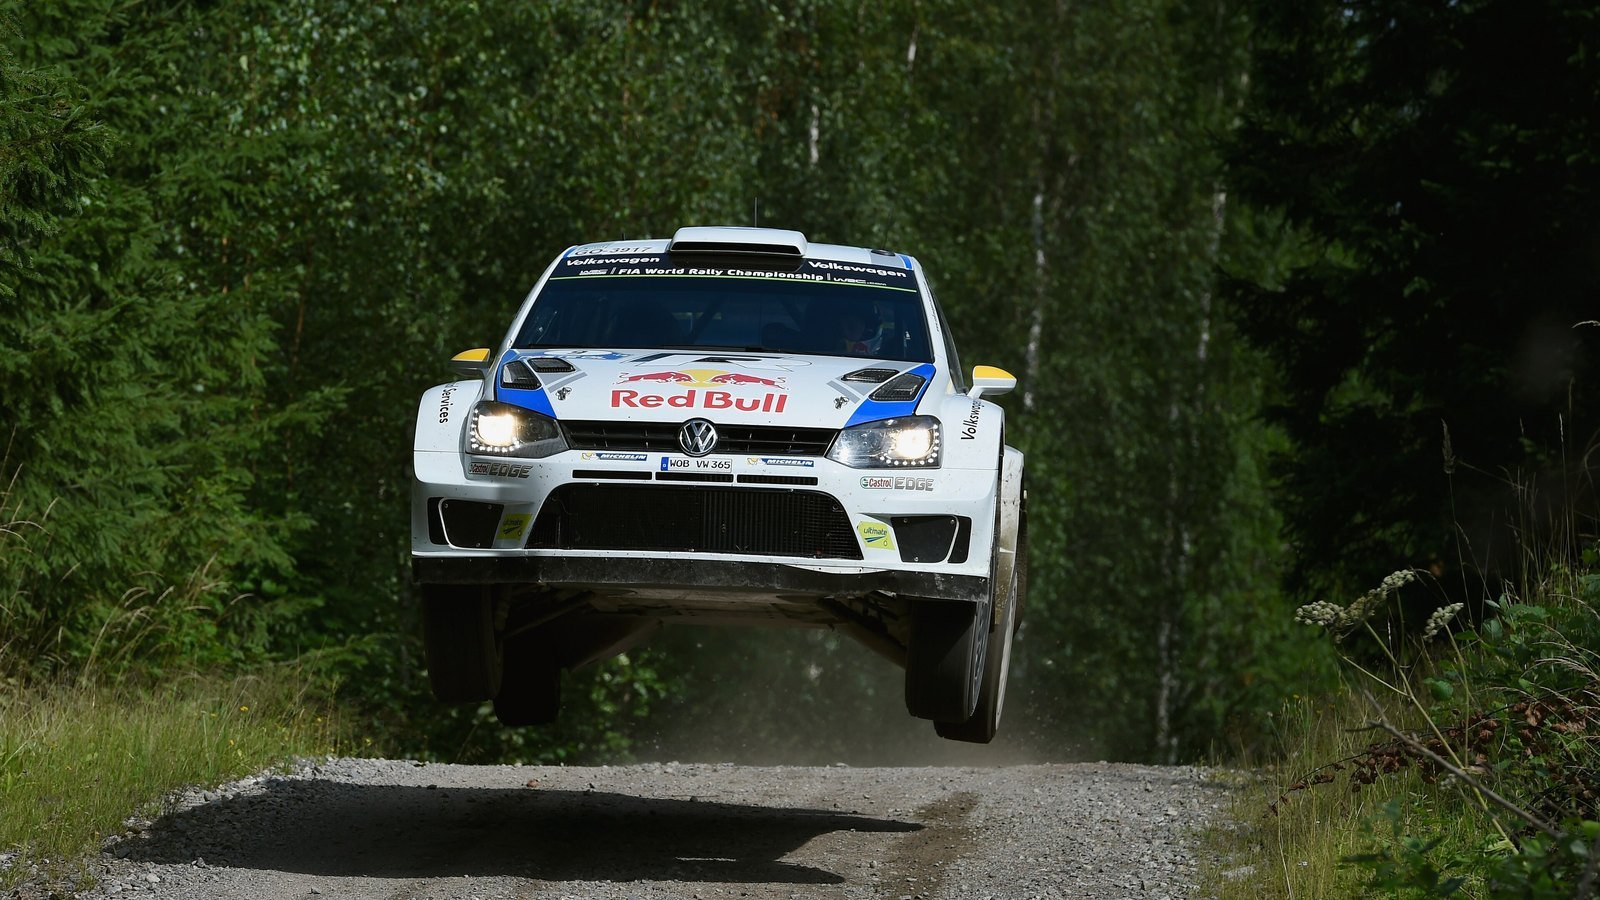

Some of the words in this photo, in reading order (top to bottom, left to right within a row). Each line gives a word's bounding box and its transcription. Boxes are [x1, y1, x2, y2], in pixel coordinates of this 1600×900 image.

[566, 257, 660, 266] Volkswagen
[688, 268, 724, 276] Rally
[727, 269, 824, 281] Championship
[808, 260, 907, 278] Volkswagen
[438, 387, 457, 424] Services
[611, 389, 696, 408] Red
[703, 390, 788, 413] Bull
[489, 463, 534, 478] EDGE
[669, 459, 690, 468] WOB
[696, 460, 709, 468] VW
[711, 461, 731, 469] 365
[868, 478, 892, 488] Castrol
[894, 477, 934, 491] EDGE
[863, 525, 888, 535] ultimate
